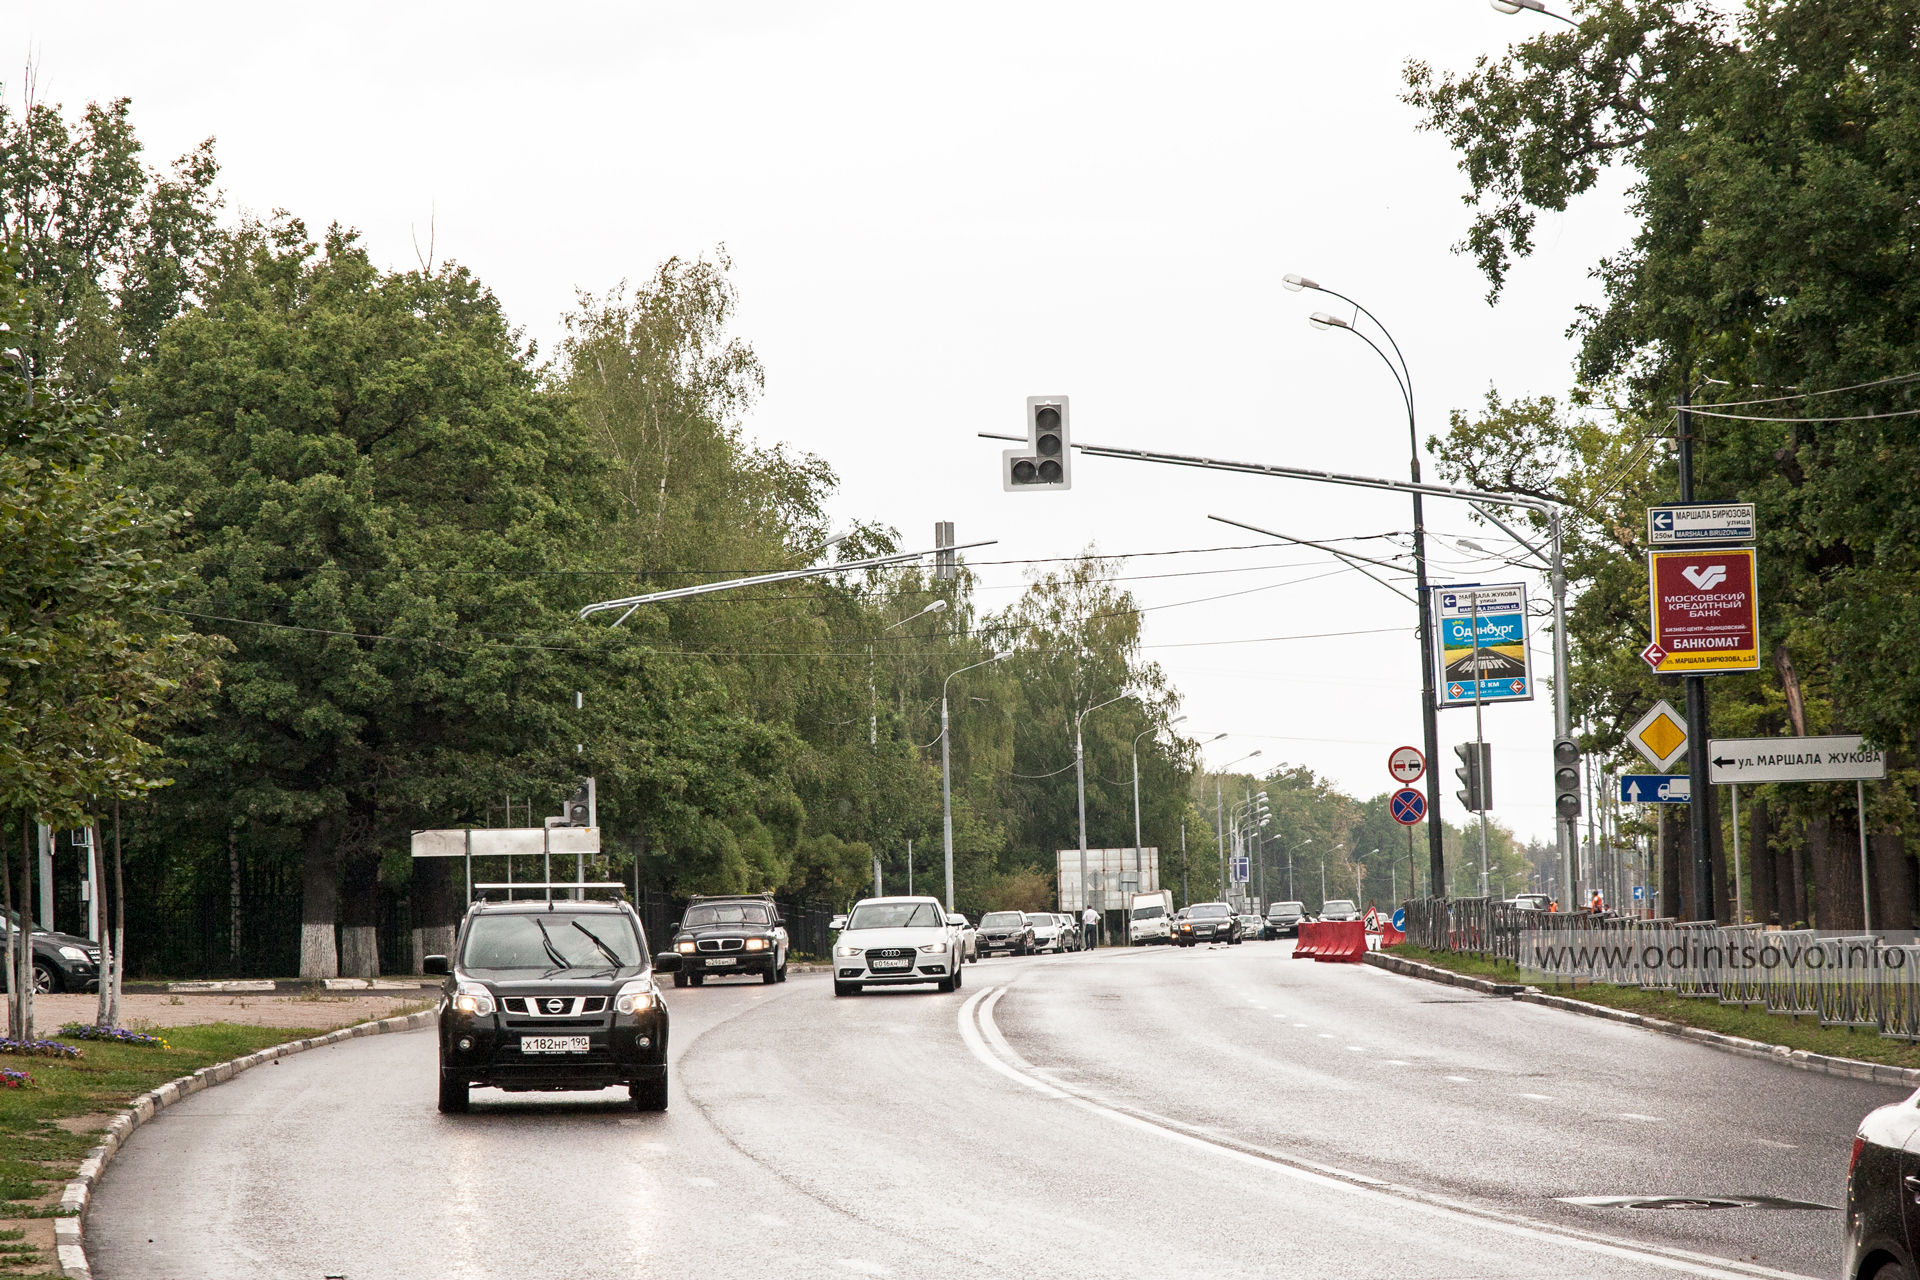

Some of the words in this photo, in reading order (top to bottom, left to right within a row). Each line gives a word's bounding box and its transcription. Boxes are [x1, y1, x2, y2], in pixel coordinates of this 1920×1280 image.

[1676, 510, 1711, 520] МАРШАЛА
[1712, 508, 1750, 519] БИРЮЗОВА
[1664, 592, 1745, 603] МОСКОВСКИЙ
[1668, 600, 1742, 610] КРЕДИТНЫЙ
[1673, 637, 1740, 649] БАНКОМАТ
[1738, 758, 1754, 769] ул.
[1757, 753, 1822, 766] МАРШАЛА
[1828, 751, 1881, 764] ЖУКОВА
[571, 1038, 587, 1046] 190
